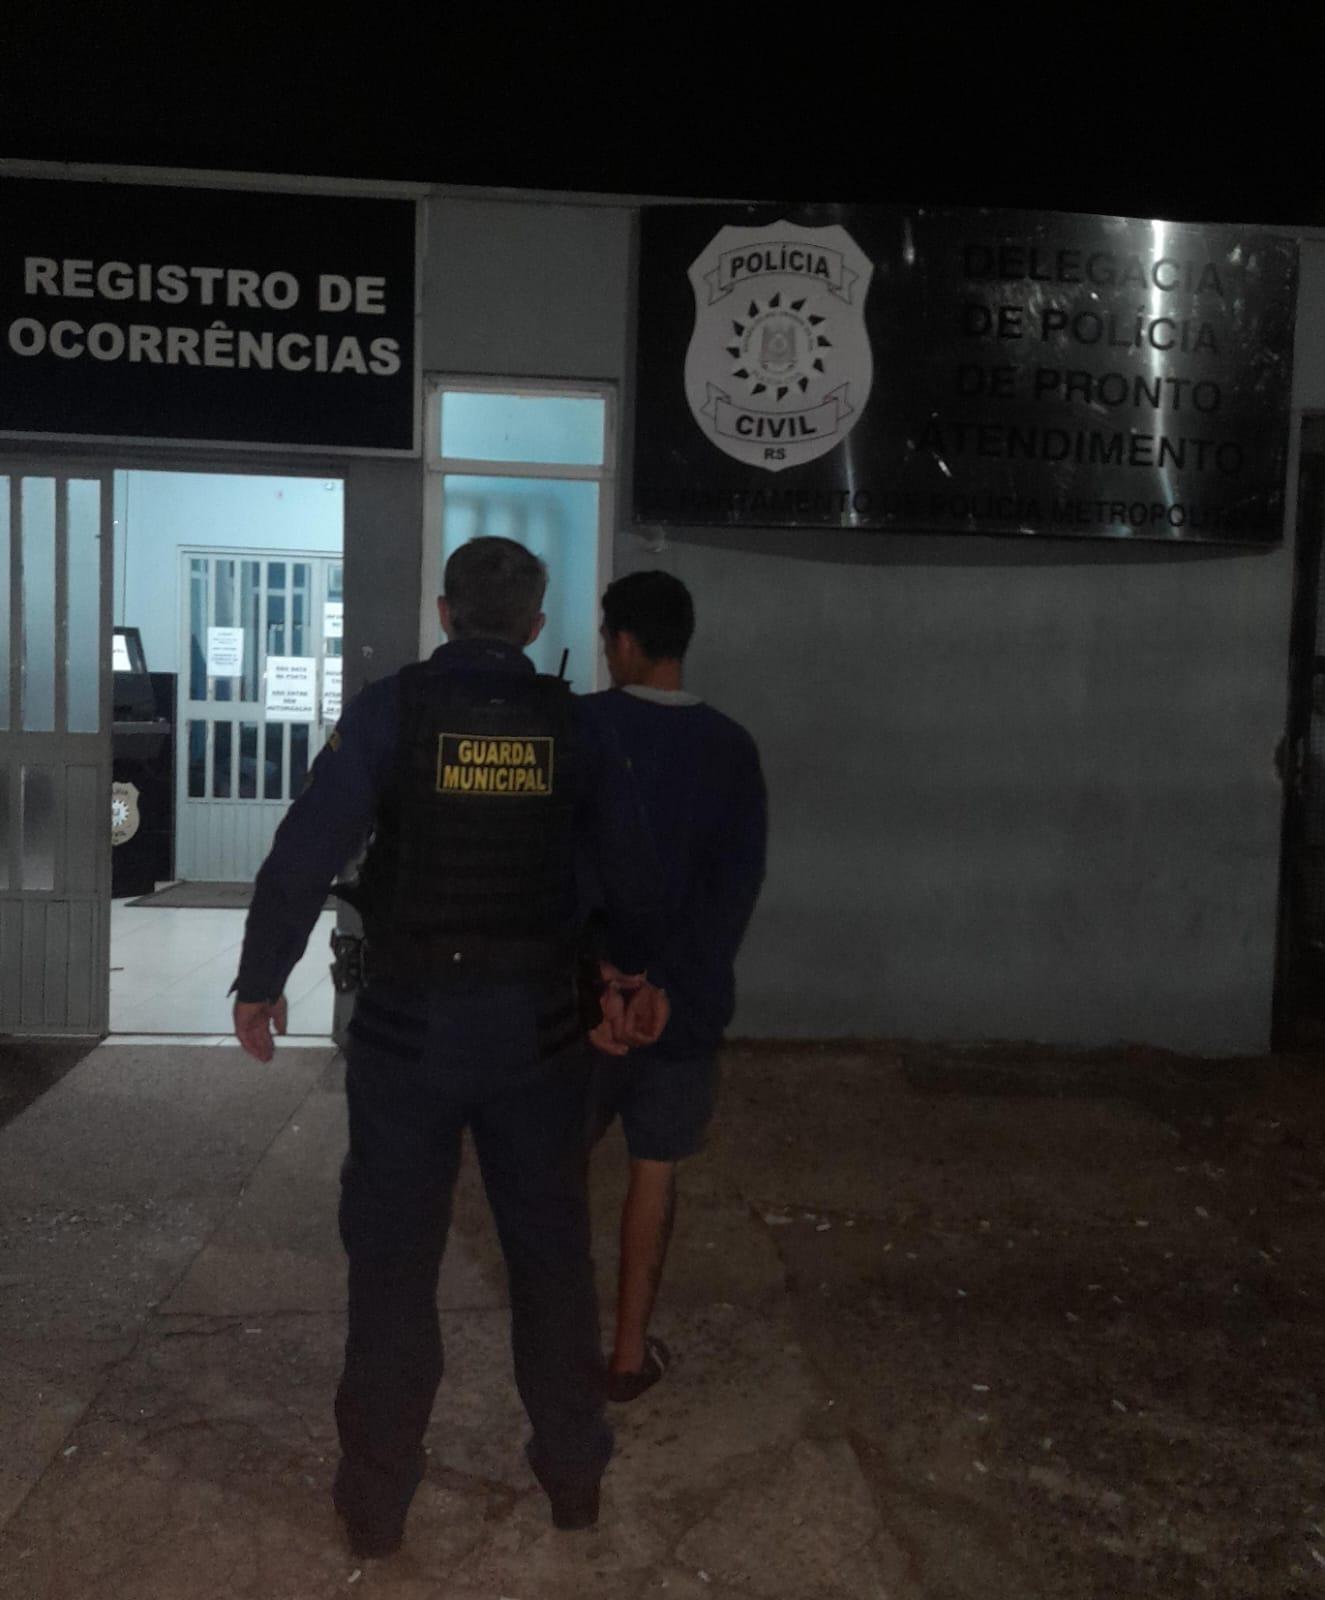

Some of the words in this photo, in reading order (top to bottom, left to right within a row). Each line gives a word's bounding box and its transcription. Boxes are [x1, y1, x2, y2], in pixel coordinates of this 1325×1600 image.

[24, 256, 299, 310] REGISTRO
[318, 273, 386, 314] DE
[731, 244, 831, 278] POLÍCIA
[962, 243, 1225, 297] DELEGACIA
[8, 317, 401, 376] OCORRÊNCIAS
[963, 303, 1023, 340] DE
[1041, 304, 1219, 354] POLÍCIA
[956, 363, 1017, 399] DE
[1034, 367, 1222, 414] PRONTO
[736, 415, 817, 438] CIVIL
[915, 421, 1244, 476] ATENDIMENTO
[764, 447, 786, 460] RS
[639, 487, 873, 514] PARTAMENTO
[1053, 498, 1276, 533] METROPOLIT
[458, 739, 537, 766] GUARDA
[442, 764, 548, 791] MUNICIPAL
